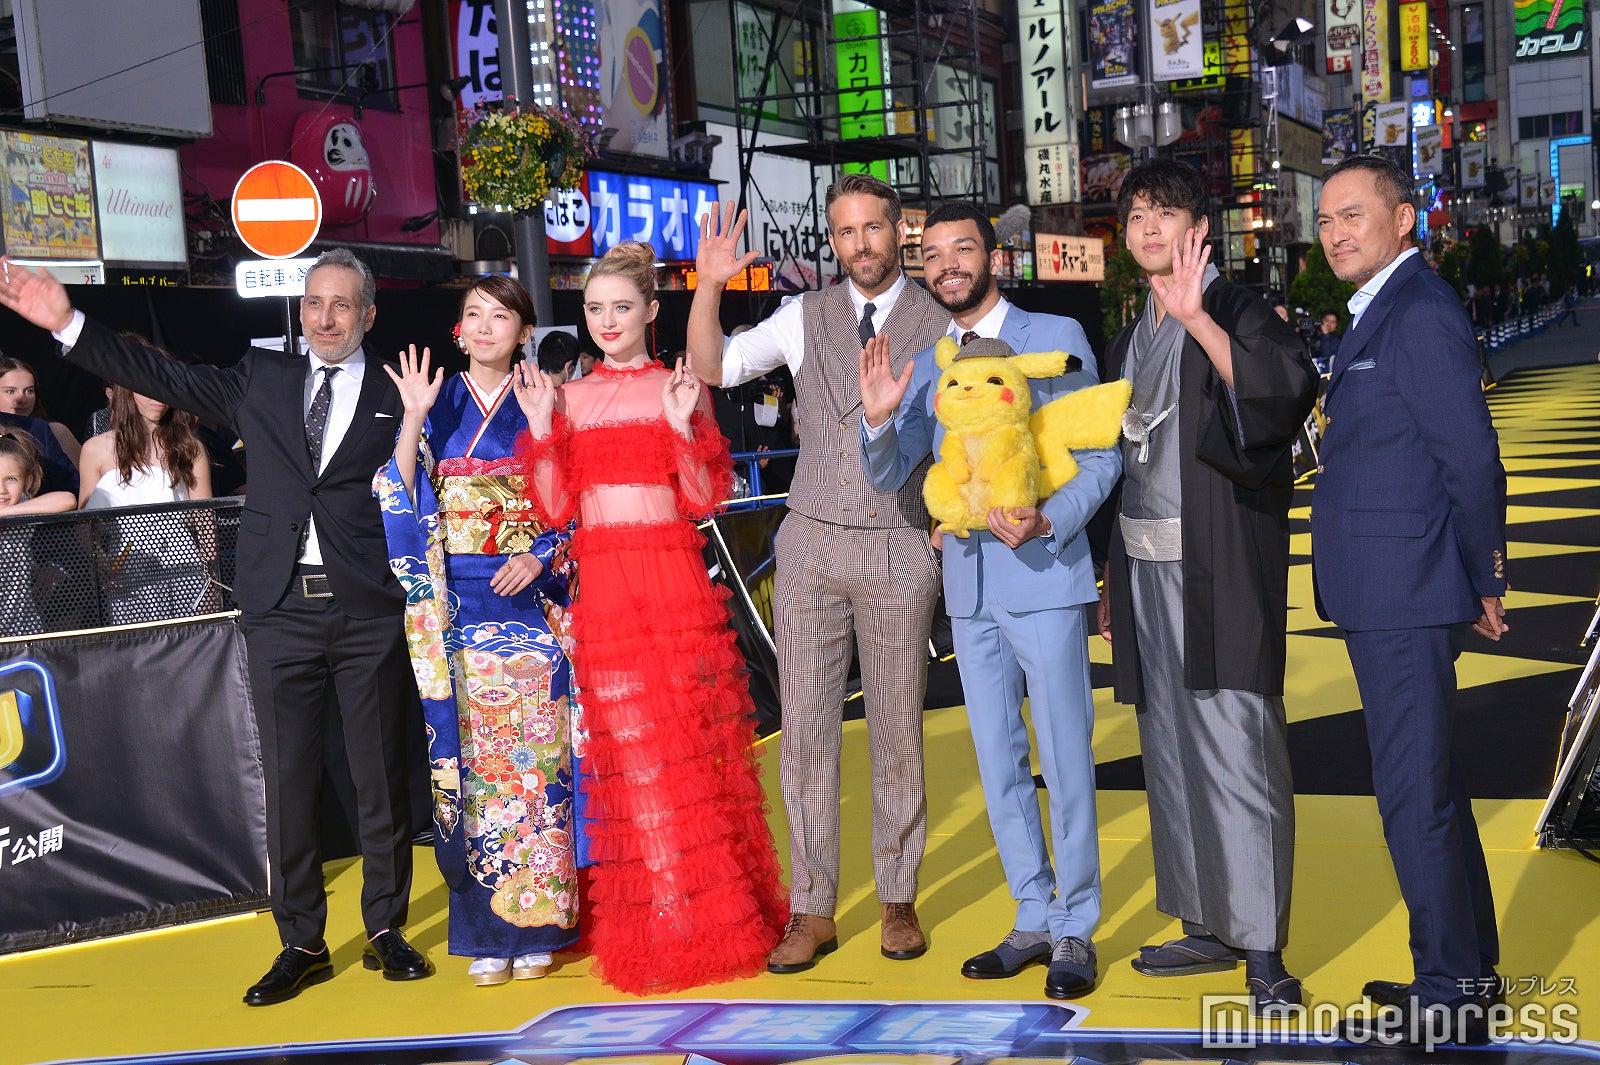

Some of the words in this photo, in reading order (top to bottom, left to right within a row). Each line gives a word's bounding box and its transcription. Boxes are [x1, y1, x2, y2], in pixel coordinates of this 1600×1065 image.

[1515, 30, 1583, 57] カワノ
[1038, 148, 1052, 203] 磯丸水産
[105, 187, 174, 218] Ultimate
